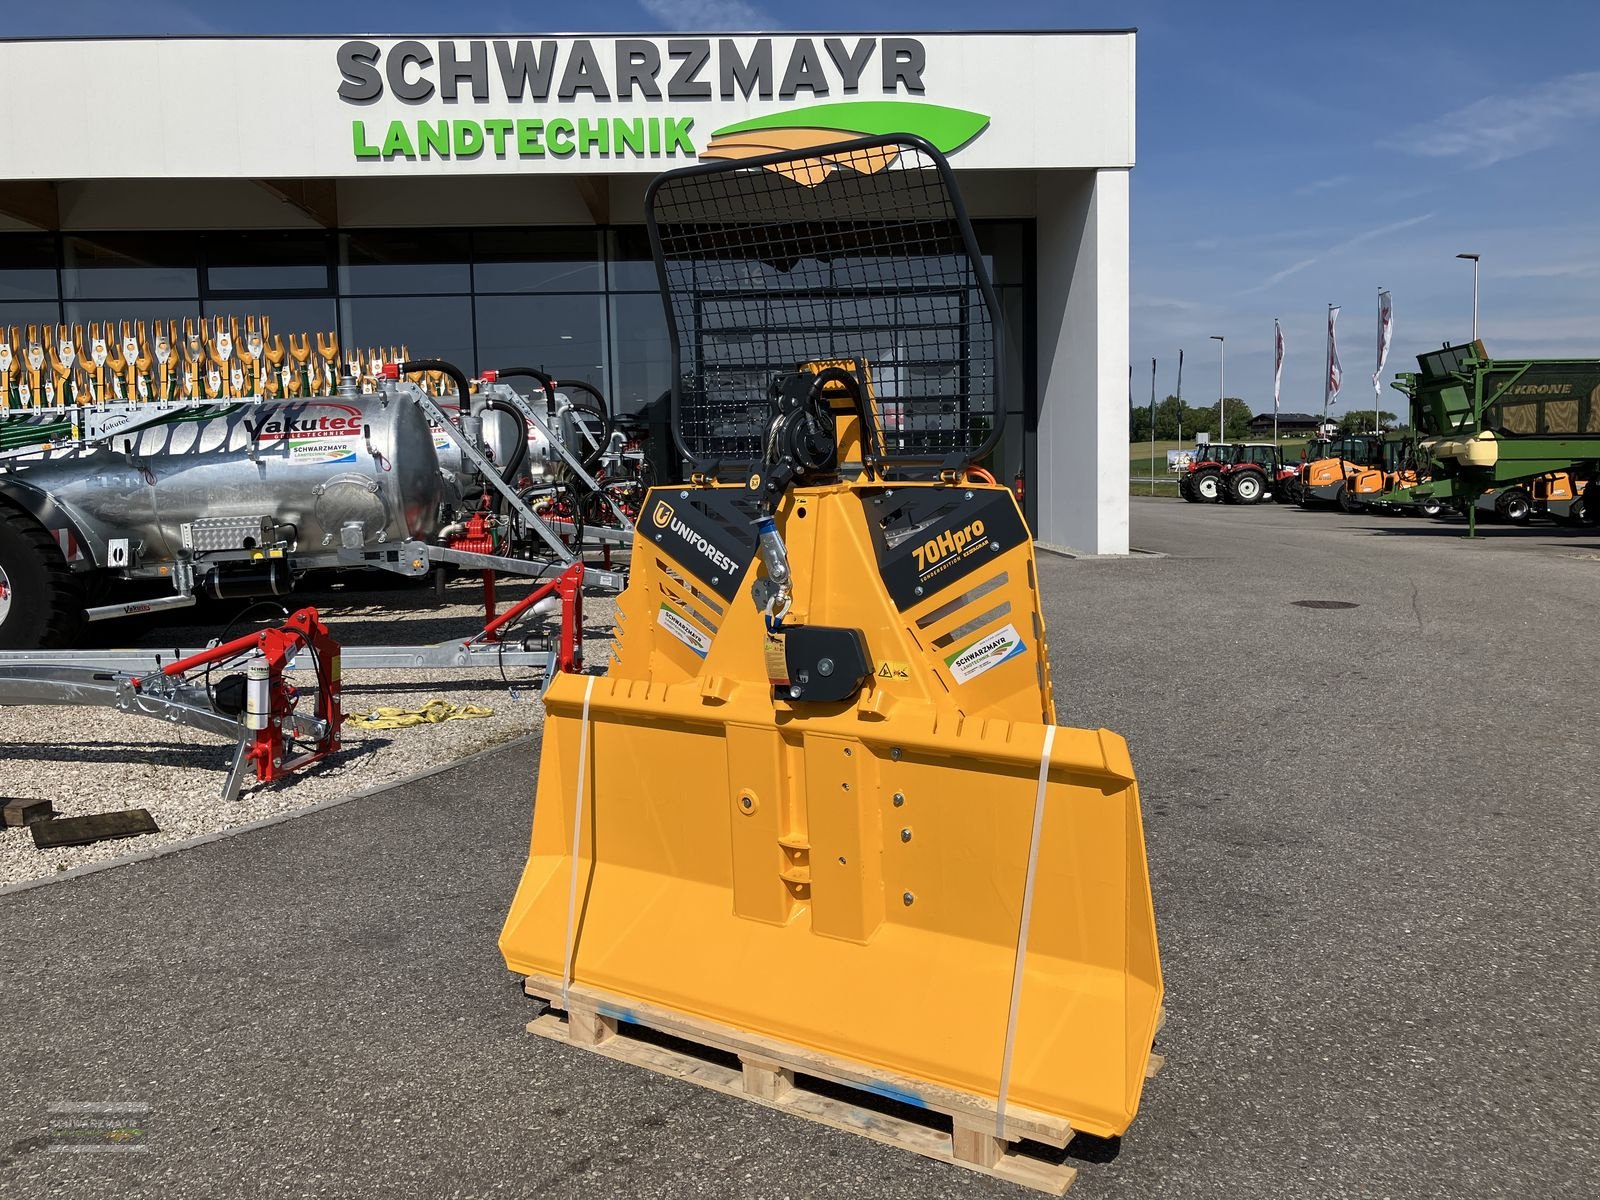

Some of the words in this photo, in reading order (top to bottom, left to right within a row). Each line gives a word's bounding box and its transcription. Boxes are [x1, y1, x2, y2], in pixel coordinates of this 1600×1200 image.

[336, 38, 926, 102] SCHWARZMAYR
[352, 117, 696, 158] LANDTECHNIK
[1514, 384, 1572, 395] KRONE
[99, 417, 129, 434] Vakutec
[244, 412, 362, 441] Vakutec
[293, 444, 347, 453] SCHWARZMAYR
[670, 517, 739, 576] UNIFOREST
[912, 520, 985, 572] 70Hpro
[665, 611, 702, 642] SCHWARZMAYR
[955, 637, 1006, 667] SCHWARZMAYR
